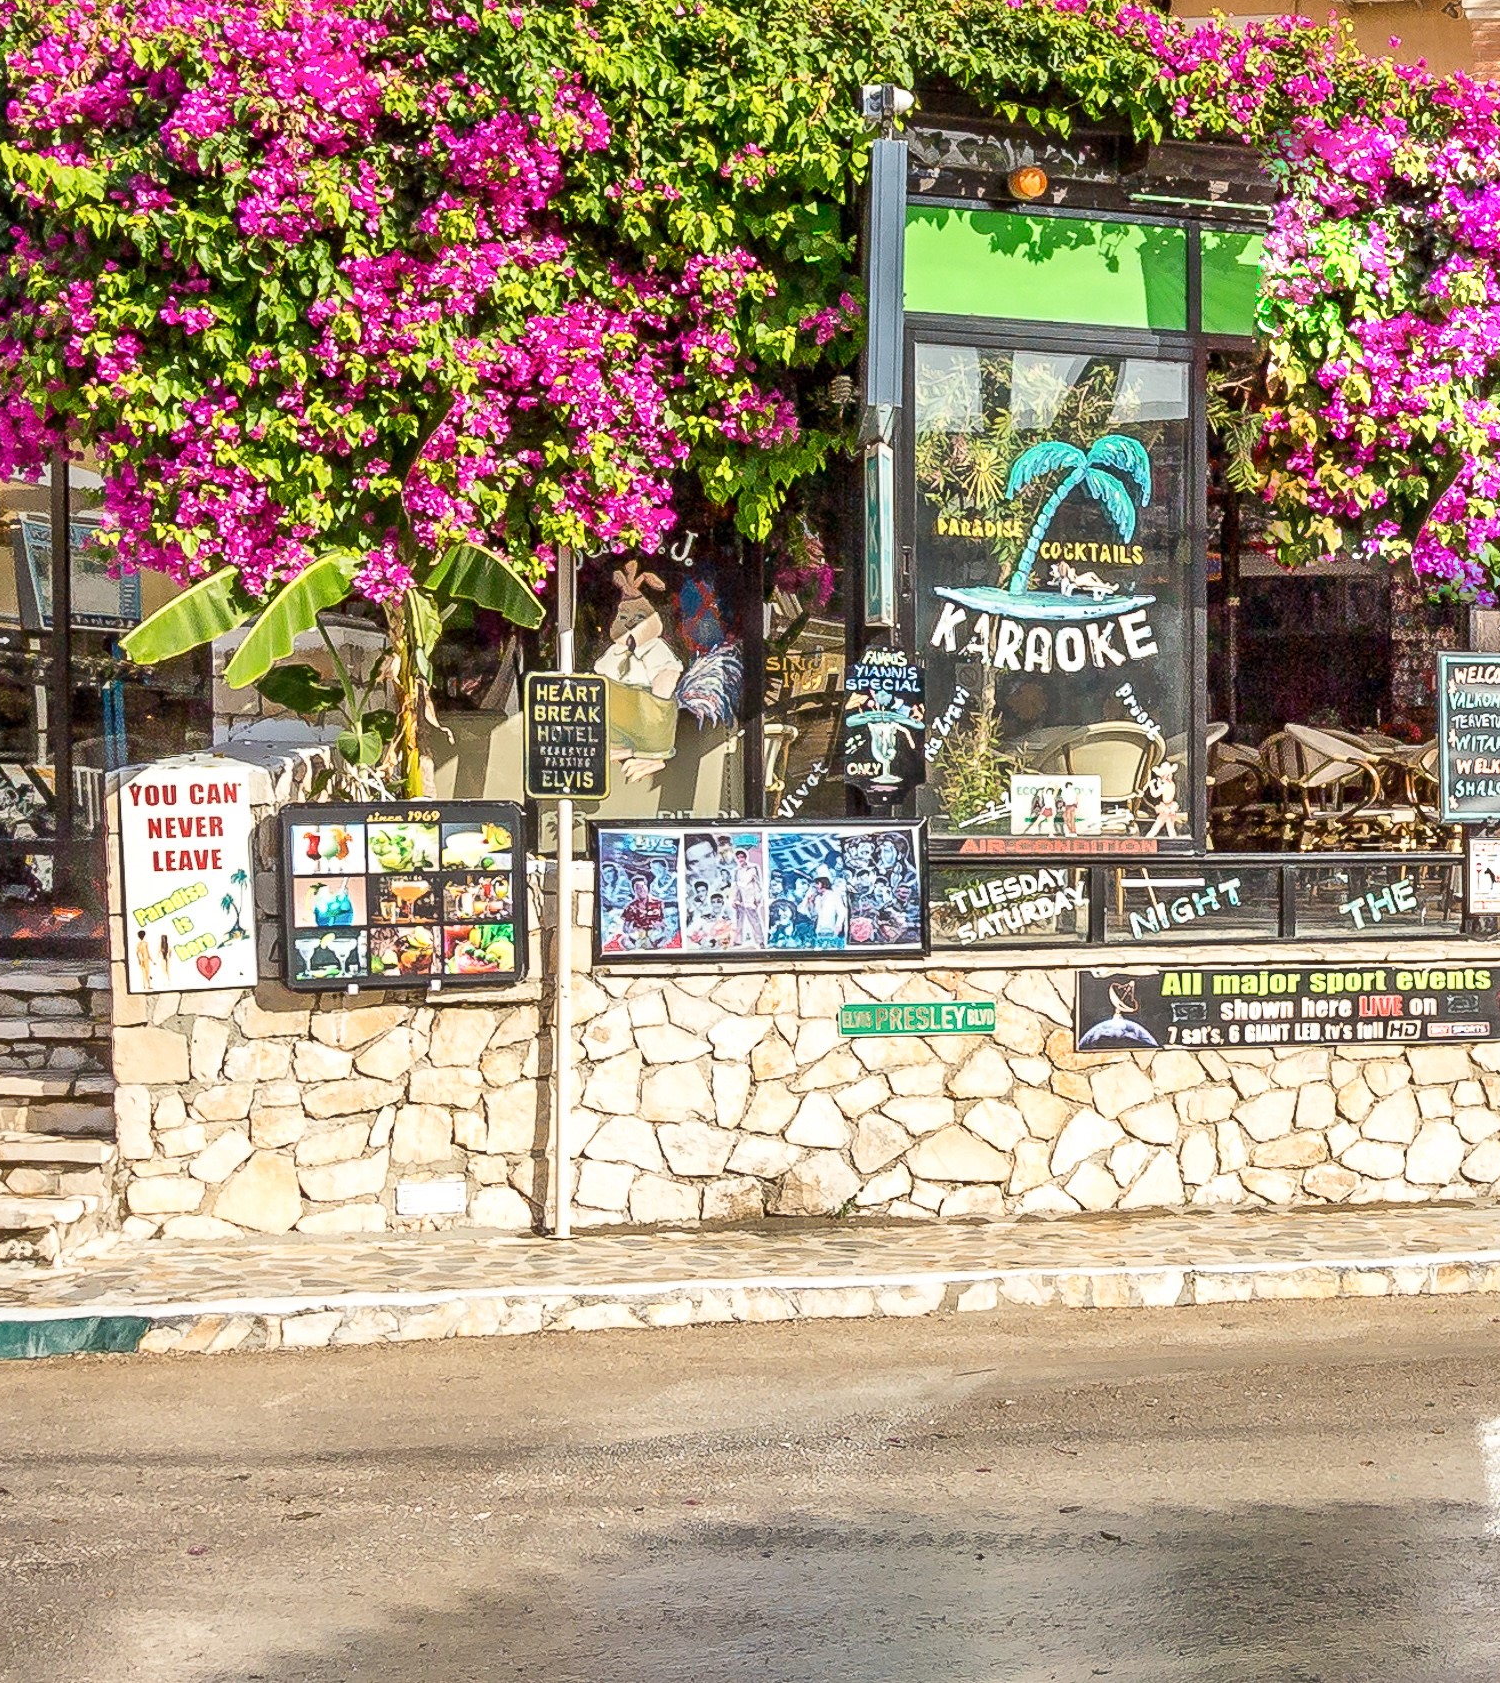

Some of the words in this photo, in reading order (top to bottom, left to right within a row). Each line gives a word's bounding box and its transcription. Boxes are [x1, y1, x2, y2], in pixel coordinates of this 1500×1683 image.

[937, 518, 1024, 538] PARADISE
[1039, 540, 1145, 566] COCKTAILS
[929, 600, 1159, 674] KARAOKE
[854, 664, 918, 680] YIANNIS
[536, 684, 601, 702] HEART
[845, 678, 921, 693] SPECIAL
[533, 704, 601, 723] BREAK
[536, 724, 599, 742] HOTEL
[541, 769, 595, 789] ELVIS
[846, 762, 881, 776] ONLY
[128, 783, 177, 807] YOU
[189, 782, 239, 805] CAN
[147, 815, 225, 839] NEVER
[406, 810, 441, 822] 1969
[959, 838, 1159, 855] AIR-CONDITION
[152, 848, 223, 872] LEAVE
[949, 867, 1069, 915] TUESDAY
[132, 881, 209, 928] Paradise
[956, 880, 1087, 947] SATURDAY
[1128, 876, 1242, 941] NIGHT
[1338, 877, 1417, 931] THE
[173, 932, 218, 963] here
[1161, 971, 1203, 997] All
[1211, 970, 1301, 997] major
[1309, 969, 1388, 995] sport
[1395, 968, 1492, 991] events
[841, 1008, 873, 1029] ELVIS
[875, 1004, 967, 1031] PRESLEY
[966, 1008, 995, 1027] BLVD
[1220, 998, 1294, 1021] shown
[1301, 997, 1353, 1018] here
[1358, 995, 1404, 1017] LIVE
[1408, 997, 1438, 1017] on
[1167, 1026, 1178, 1045] 7
[1227, 1024, 1239, 1044] 6
[1244, 1023, 1291, 1044] GIANT
[1356, 1020, 1384, 1039] full
[1388, 1022, 1419, 1039] HD
